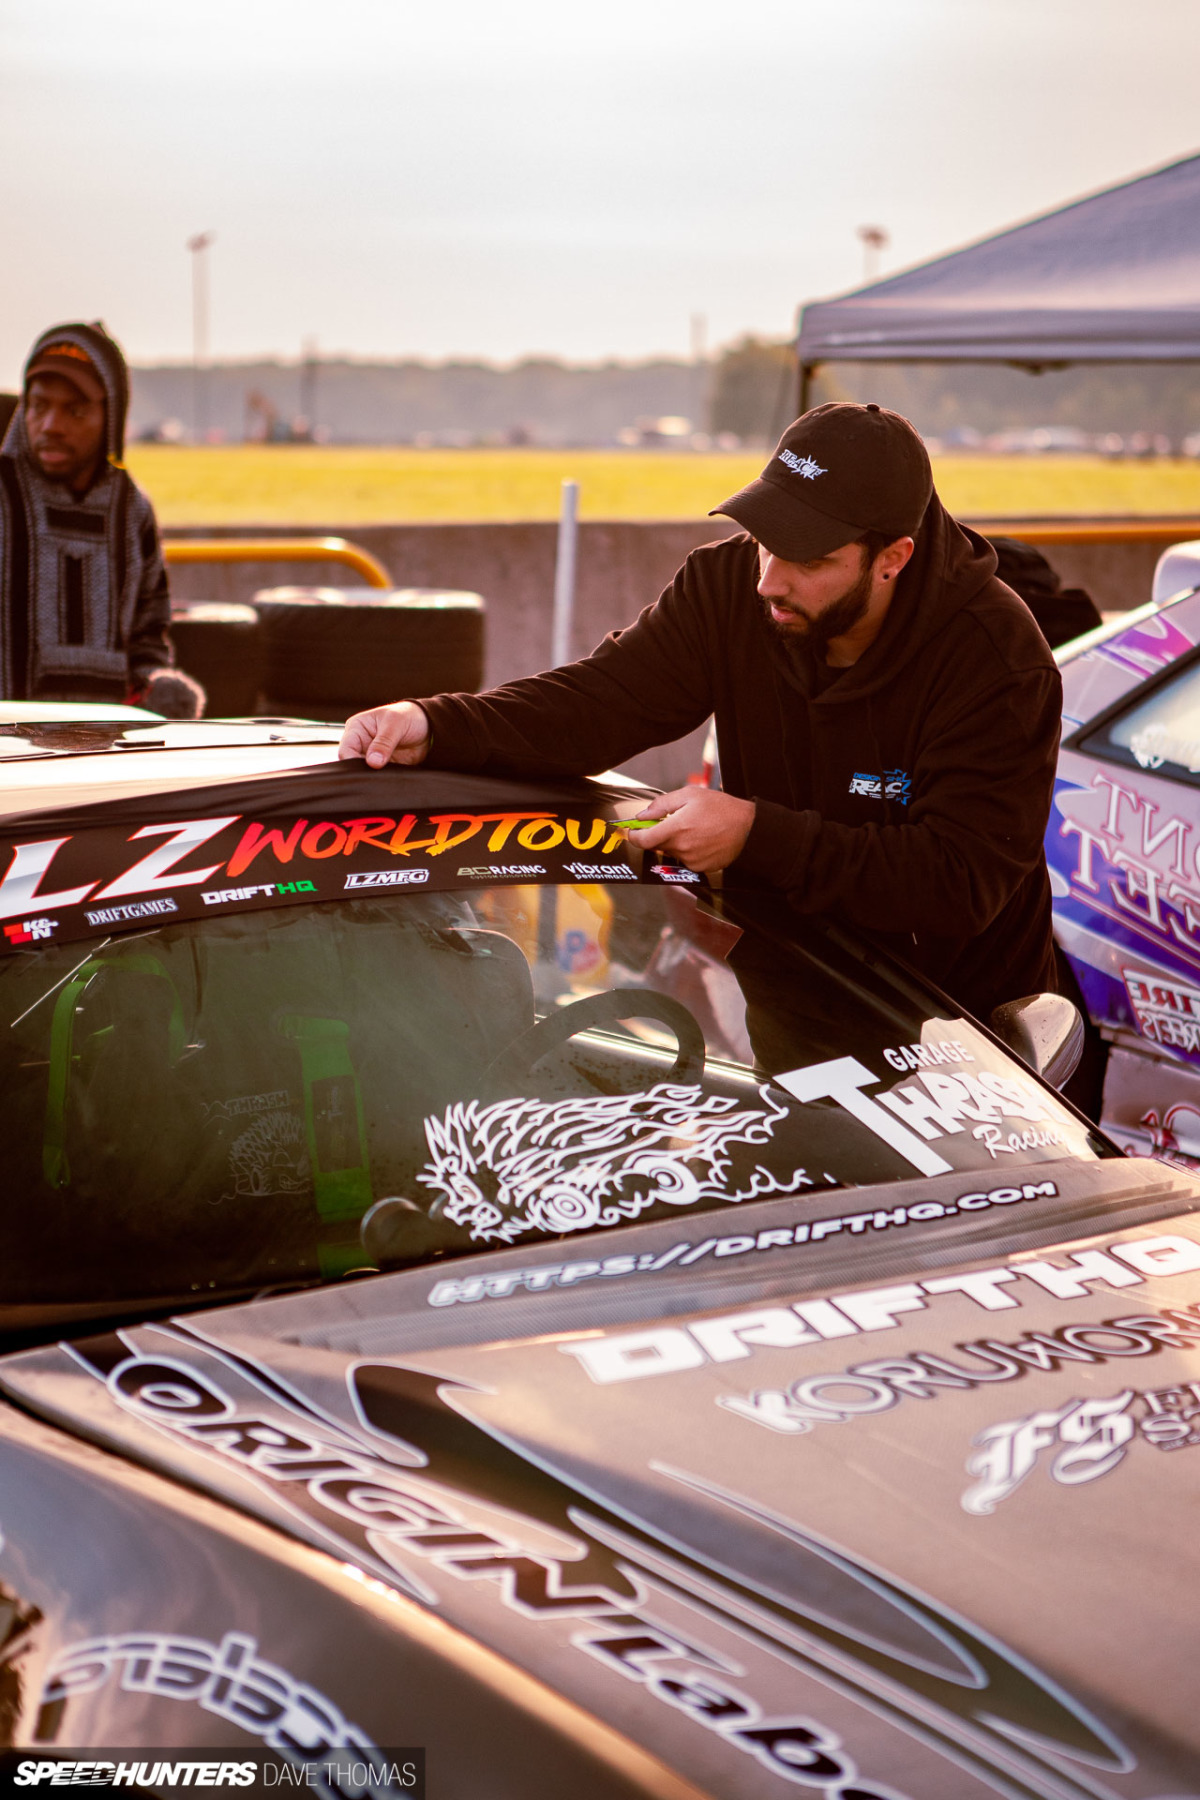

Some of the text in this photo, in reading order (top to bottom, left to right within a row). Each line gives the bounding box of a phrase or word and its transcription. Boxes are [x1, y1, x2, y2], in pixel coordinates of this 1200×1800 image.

[779, 449, 823, 478] REACT
[848, 778, 907, 796] REAC
[0, 815, 243, 919] LZ
[346, 870, 428, 889] LZMFG
[562, 863, 634, 877] vibrant
[85, 898, 178, 926] DRIFTGAMES
[883, 1040, 975, 1072] GARAGE
[772, 1056, 1072, 1177] THRASH
[557, 1235, 1200, 1384] DRIFTHQ
[107, 1355, 643, 1620] ORIGIN
[569, 1632, 912, 1800] Lab
